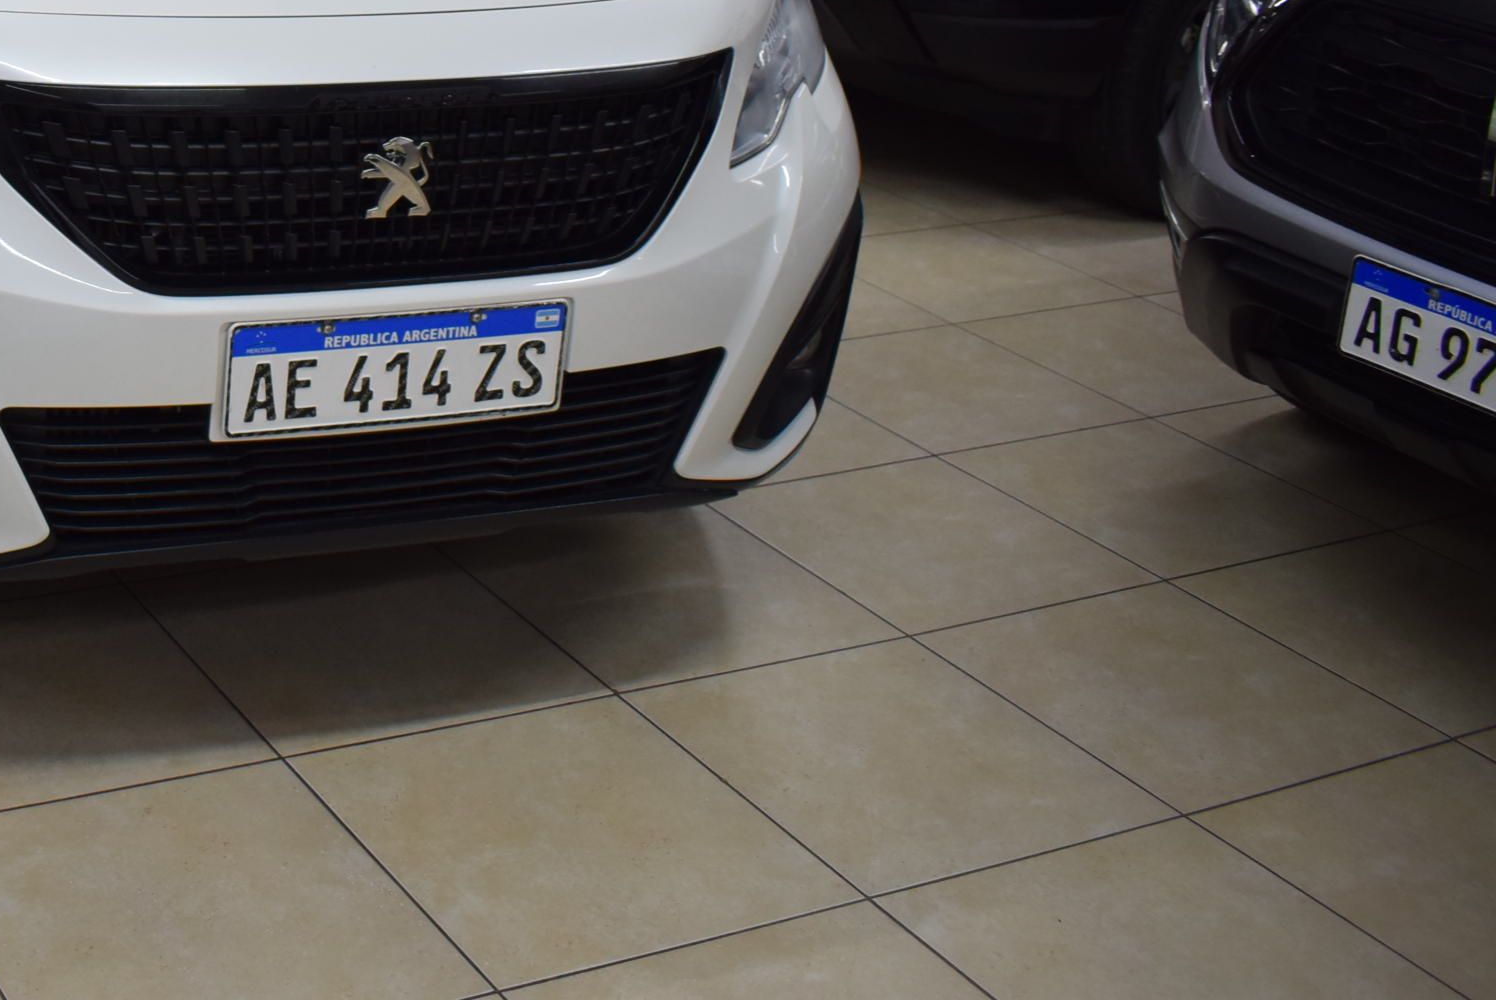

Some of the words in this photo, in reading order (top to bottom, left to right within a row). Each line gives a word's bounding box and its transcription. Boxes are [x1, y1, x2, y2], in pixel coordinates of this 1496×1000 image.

[324, 331, 399, 349] REPUBLICA
[403, 325, 478, 342] ARGENTINA
[1354, 297, 1422, 367] AG
[243, 358, 318, 423] AE
[343, 349, 452, 413] 414
[474, 340, 547, 403] ZS
